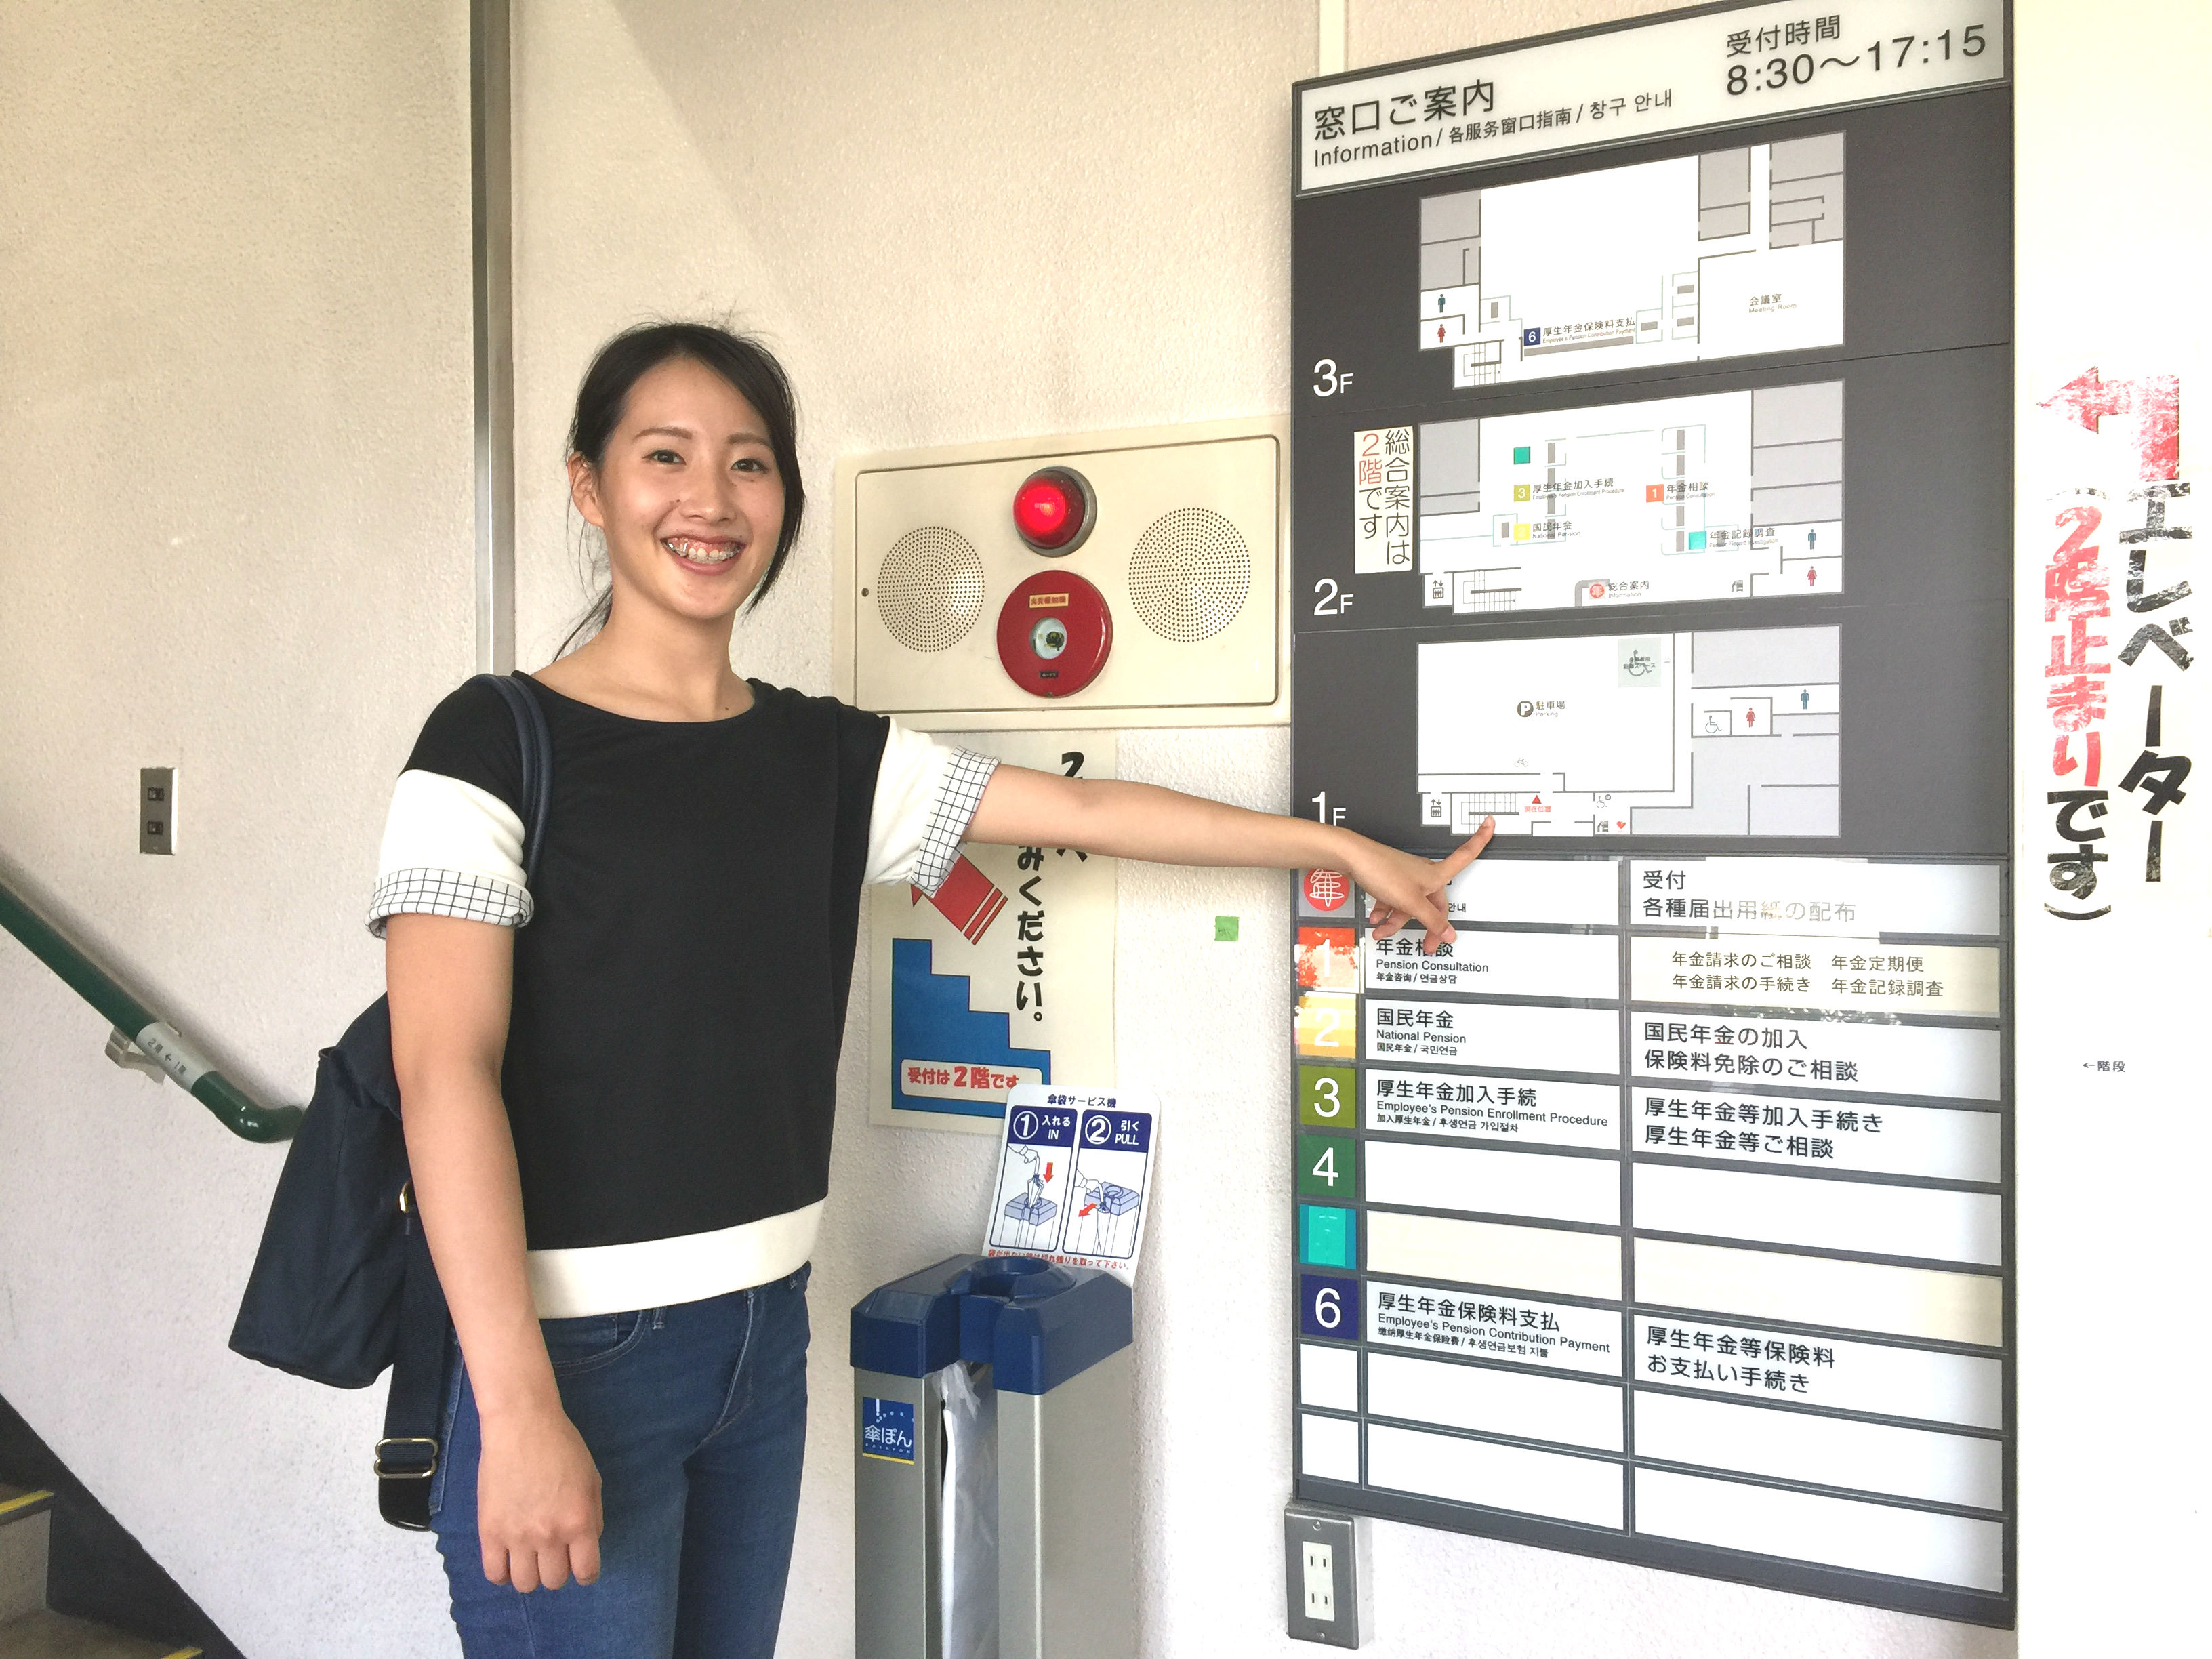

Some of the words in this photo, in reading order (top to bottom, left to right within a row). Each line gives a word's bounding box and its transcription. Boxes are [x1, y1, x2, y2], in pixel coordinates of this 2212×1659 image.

[1726, 14, 1841, 58] 受付時間
[1315, 79, 1494, 141] 窓口ご案内
[1315, 133, 1433, 168] Information
[1448, 107, 1572, 144] 各服务窗口指南
[1589, 97, 1626, 119] 창구
[1634, 88, 1672, 112] 안내
[1749, 293, 1782, 306] 会議室
[1528, 331, 1536, 342] 6
[1542, 317, 1635, 337] 厚生年金保険料支払
[1313, 359, 1354, 397] 3F
[1359, 433, 1383, 539] 2階です
[1385, 428, 1410, 565] 総合案内は
[1518, 487, 1526, 499] 3
[1532, 478, 1614, 493] 厚生年金加入手続
[1652, 488, 1658, 499] 1
[1666, 481, 1710, 493] 年金相談
[1532, 520, 1572, 532] 国民年金
[1313, 578, 1354, 616] 2F
[1608, 581, 1650, 592] 総合案内
[2118, 482, 2194, 882] エレベーター
[1536, 700, 1565, 710] 駐車場
[1643, 869, 1687, 890] 受付
[1643, 898, 1857, 922] 各種届出用紙の配布
[1315, 938, 1330, 977] 1
[1376, 959, 1418, 970] Pension
[1421, 960, 1489, 972] Consultation
[1672, 951, 1811, 970] 年金請求のご相談
[1832, 954, 1924, 973] 年金定期便
[1672, 974, 1811, 993] 年金請求の手続き
[1832, 977, 1944, 997] 年金記録調査
[1314, 1008, 1340, 1047] 2
[1377, 1008, 1454, 1029] 国民年金
[1376, 1029, 1420, 1041] National
[1423, 1031, 1467, 1043] Pension
[1645, 1021, 1808, 1050] 国民年金の加入
[1420, 1044, 1458, 1057] 국민연금
[1644, 1048, 1859, 1083] 保険料免除のご相談
[2097, 1060, 2126, 1073] 階段
[1047, 1094, 1117, 1108] 傘袋サービス機
[1313, 1076, 1340, 1118] 3
[1376, 1079, 1537, 1107] 厚生年金加入手続
[1042, 1115, 1071, 1127] 入れる
[1376, 1101, 1437, 1114] Employee's
[1441, 1105, 1483, 1117] Pension
[1487, 1108, 1546, 1122] Enrollment
[1550, 1112, 1608, 1126] Procedure
[1645, 1097, 1883, 1134] 厚生年金等加入手続き
[1048, 1129, 1059, 1140] IN
[1120, 1120, 1140, 1132] 引く
[1480, 1121, 1519, 1133] 가입절차
[1115, 1134, 1139, 1145] PULL
[1645, 1124, 1834, 1160] 厚生年金等ご相談
[1311, 1147, 1339, 1187] 4
[1314, 1287, 1341, 1329] 6
[1378, 1292, 1560, 1332] 厚生年金保険料支払
[1378, 1313, 1439, 1330] Employee's
[1442, 1322, 1486, 1336] Pension
[1488, 1327, 1556, 1345] Contribution
[1560, 1336, 1610, 1353] Payment
[1647, 1325, 1836, 1368] 厚生年金等保険料
[1647, 1354, 1810, 1394] お支払い手続き
[865, 1424, 912, 1448] 傘ぽん
